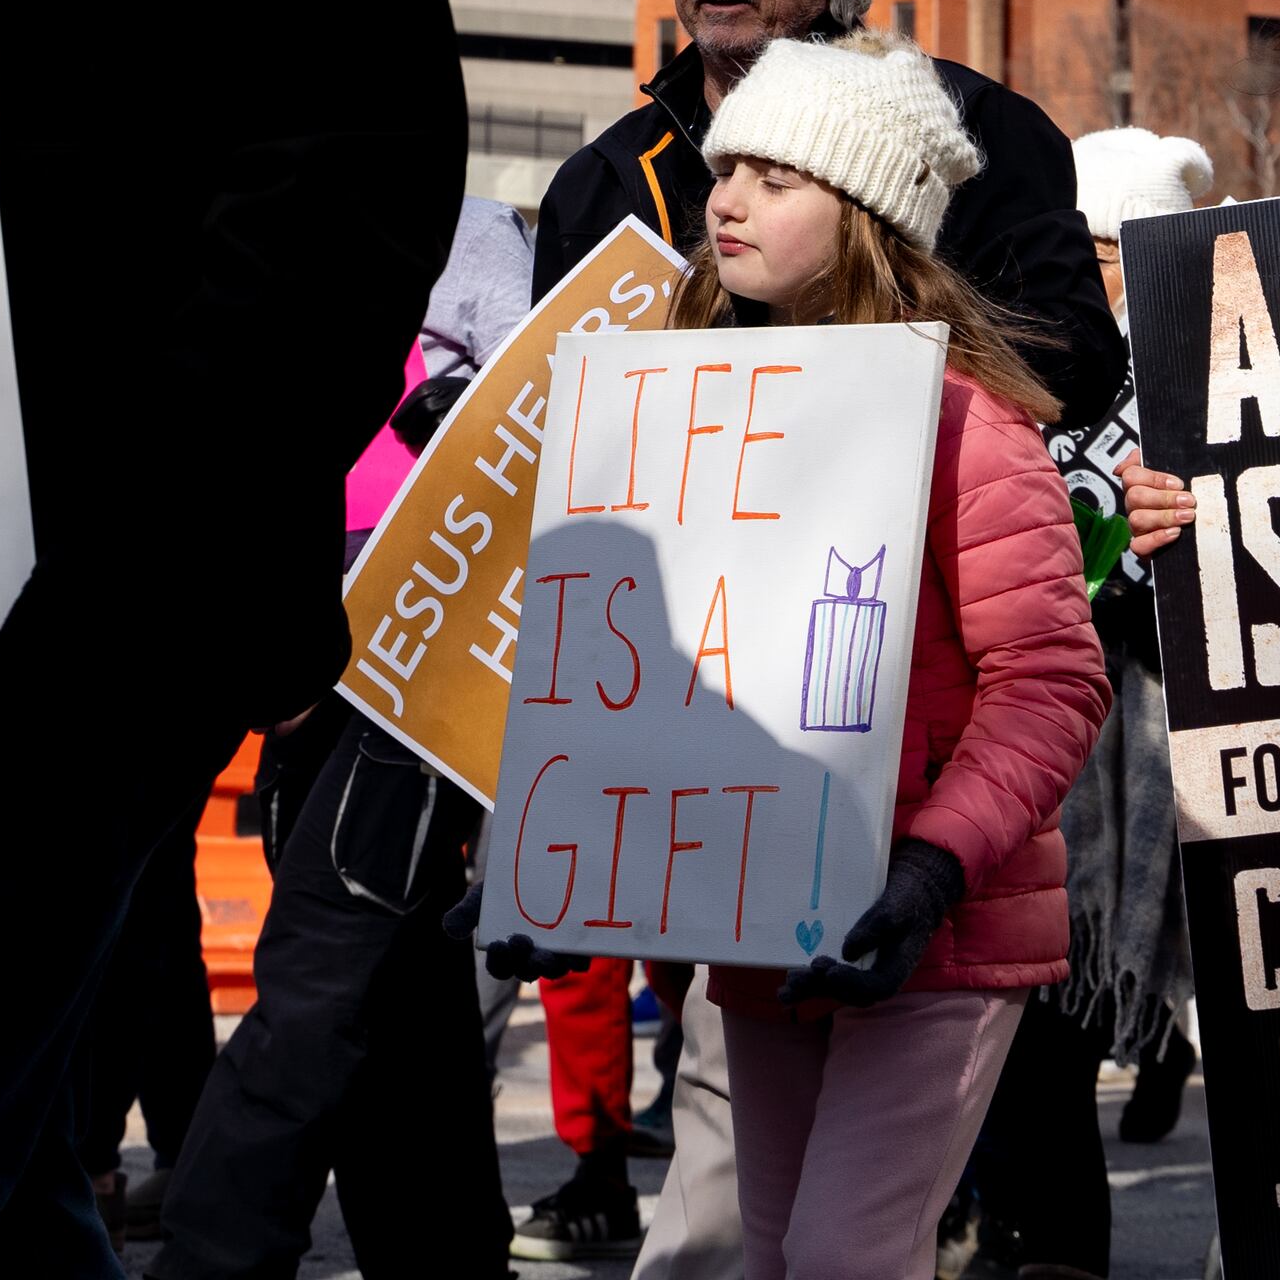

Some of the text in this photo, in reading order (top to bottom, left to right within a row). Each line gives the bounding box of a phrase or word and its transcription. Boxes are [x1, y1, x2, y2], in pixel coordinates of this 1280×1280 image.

[356, 270, 671, 719] JESUS HERS,
[565, 355, 803, 526] LIFE
[523, 571, 736, 712] IS A
